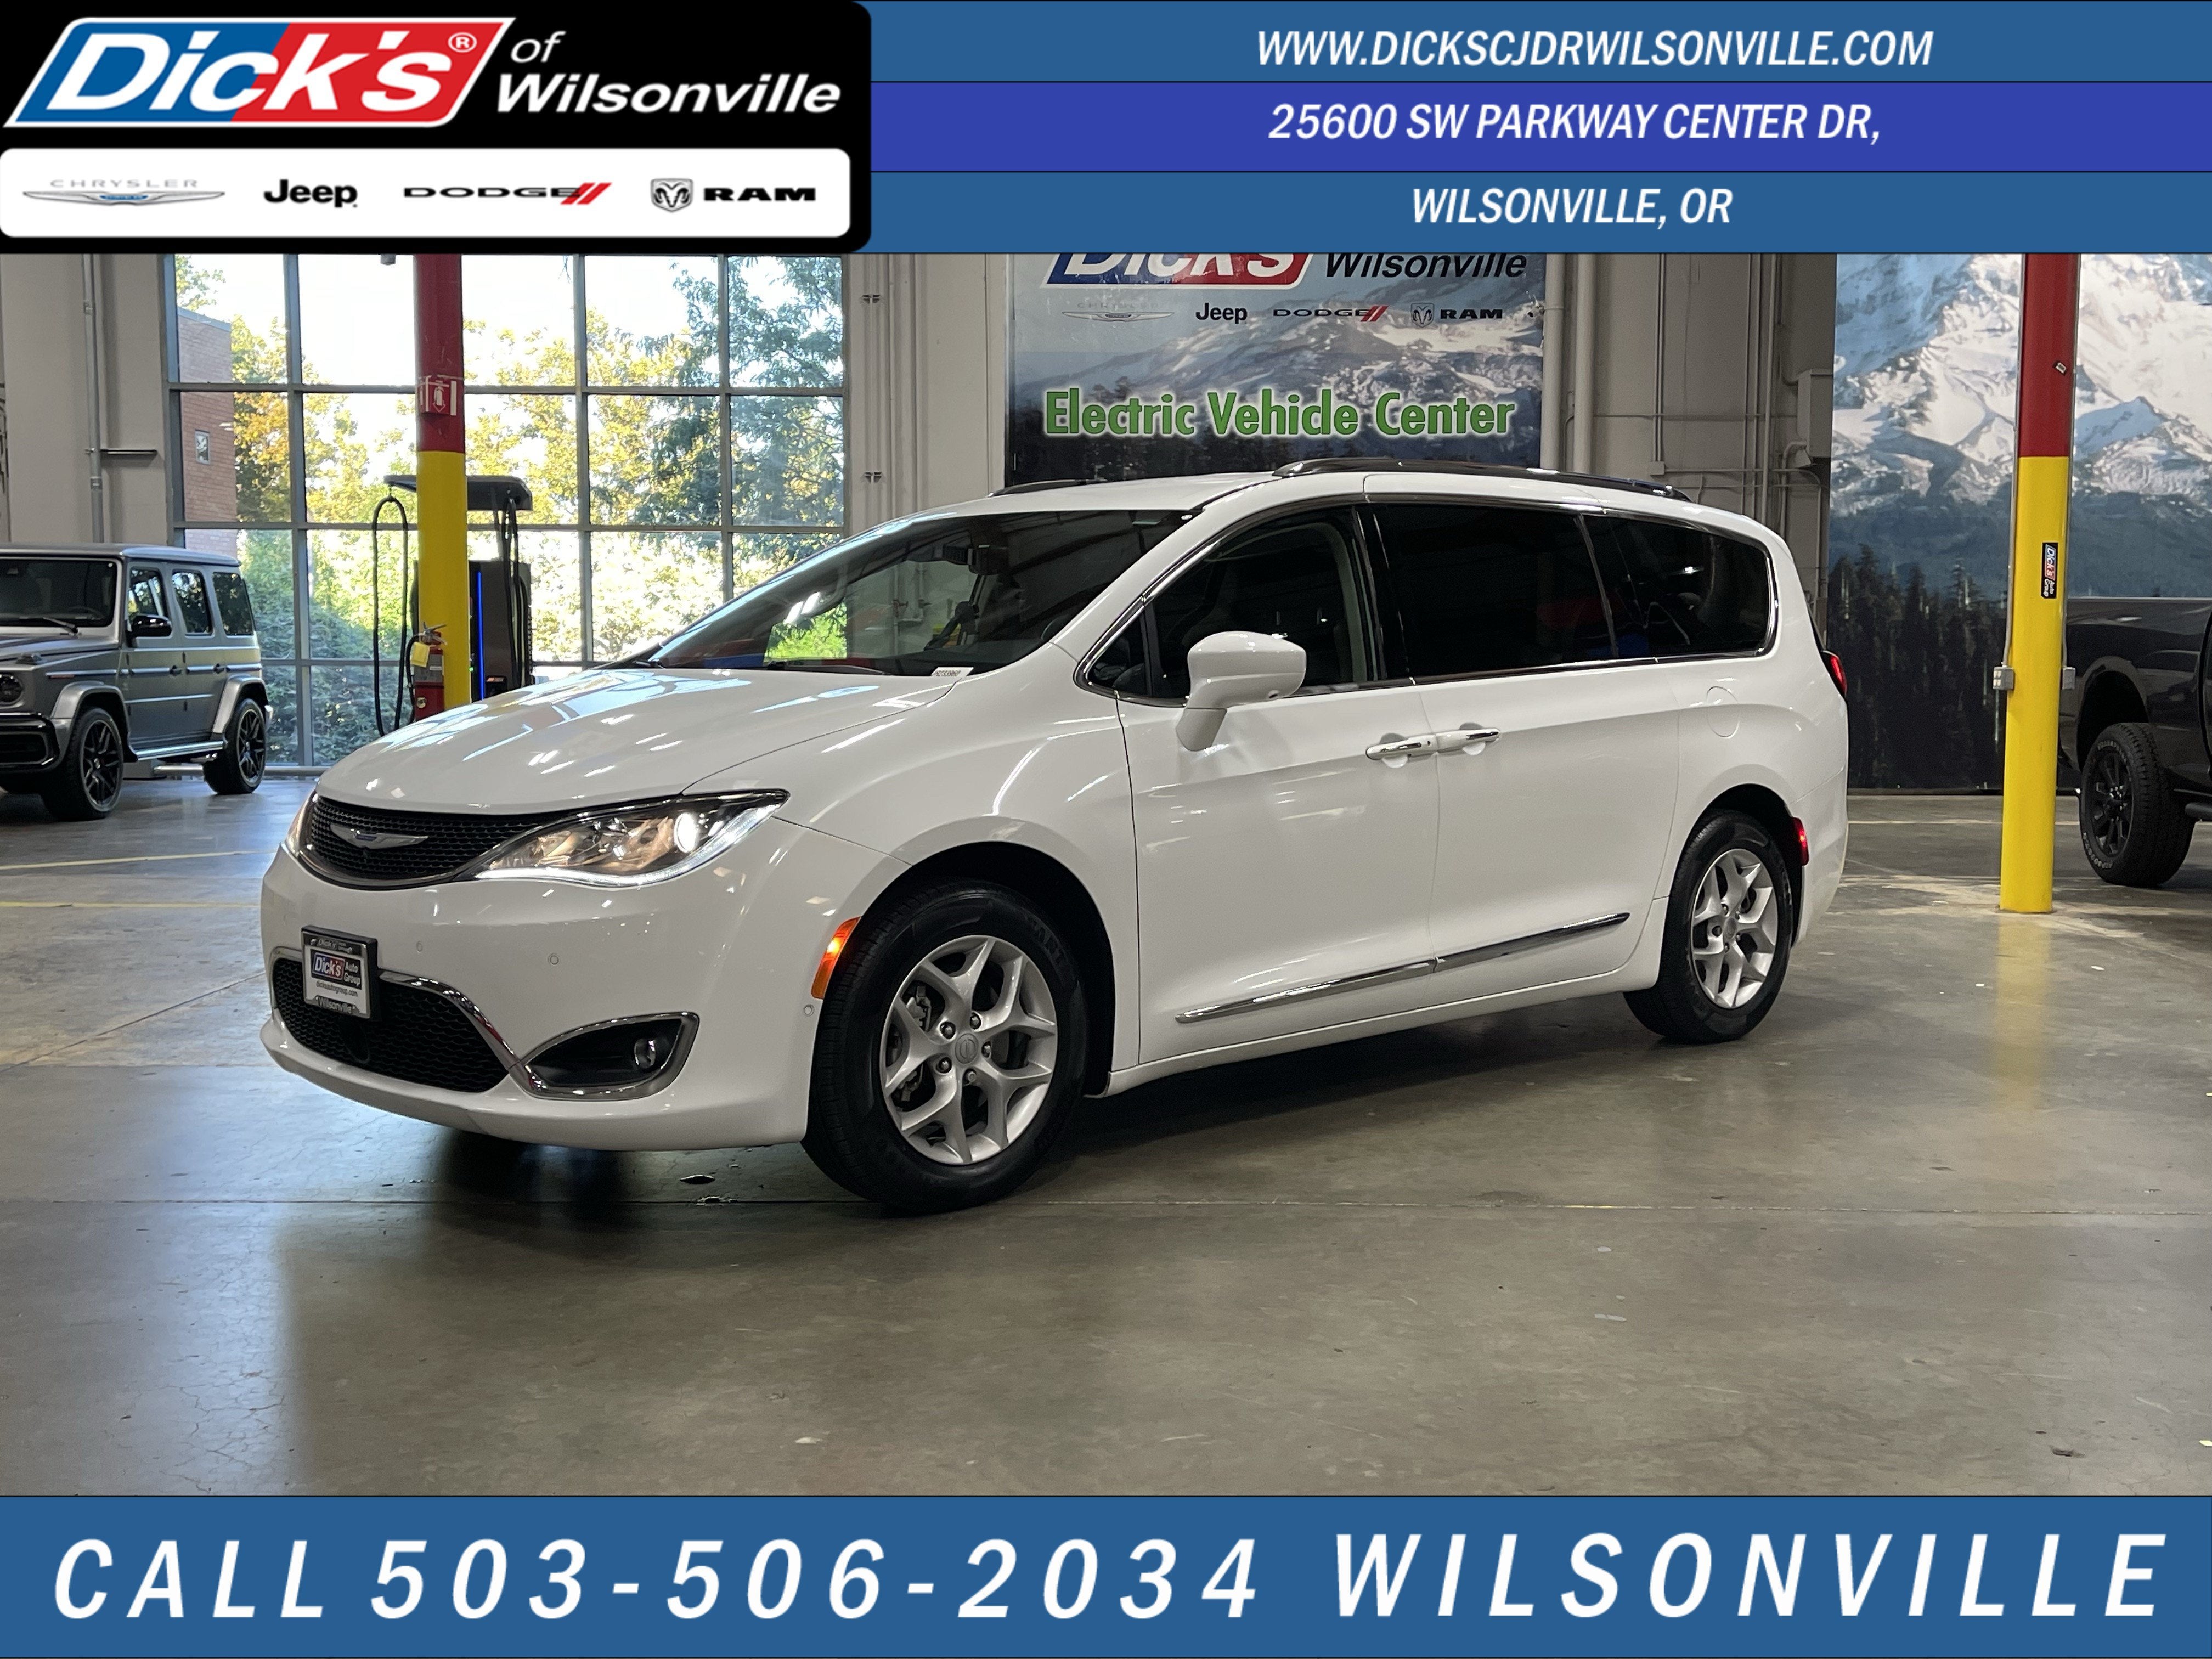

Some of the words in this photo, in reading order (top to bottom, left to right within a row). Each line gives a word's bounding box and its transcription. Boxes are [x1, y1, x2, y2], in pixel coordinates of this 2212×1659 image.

[1325, 253, 1528, 278] Wilsonville
[1195, 302, 1248, 325] Jeep
[1272, 308, 1369, 317] DODGE
[1440, 308, 1504, 320] RAM
[1045, 387, 1195, 435] Electric
[1207, 388, 1359, 436] Vehicle
[1375, 392, 1516, 436] Center
[315, 957, 341, 977] Dick's
